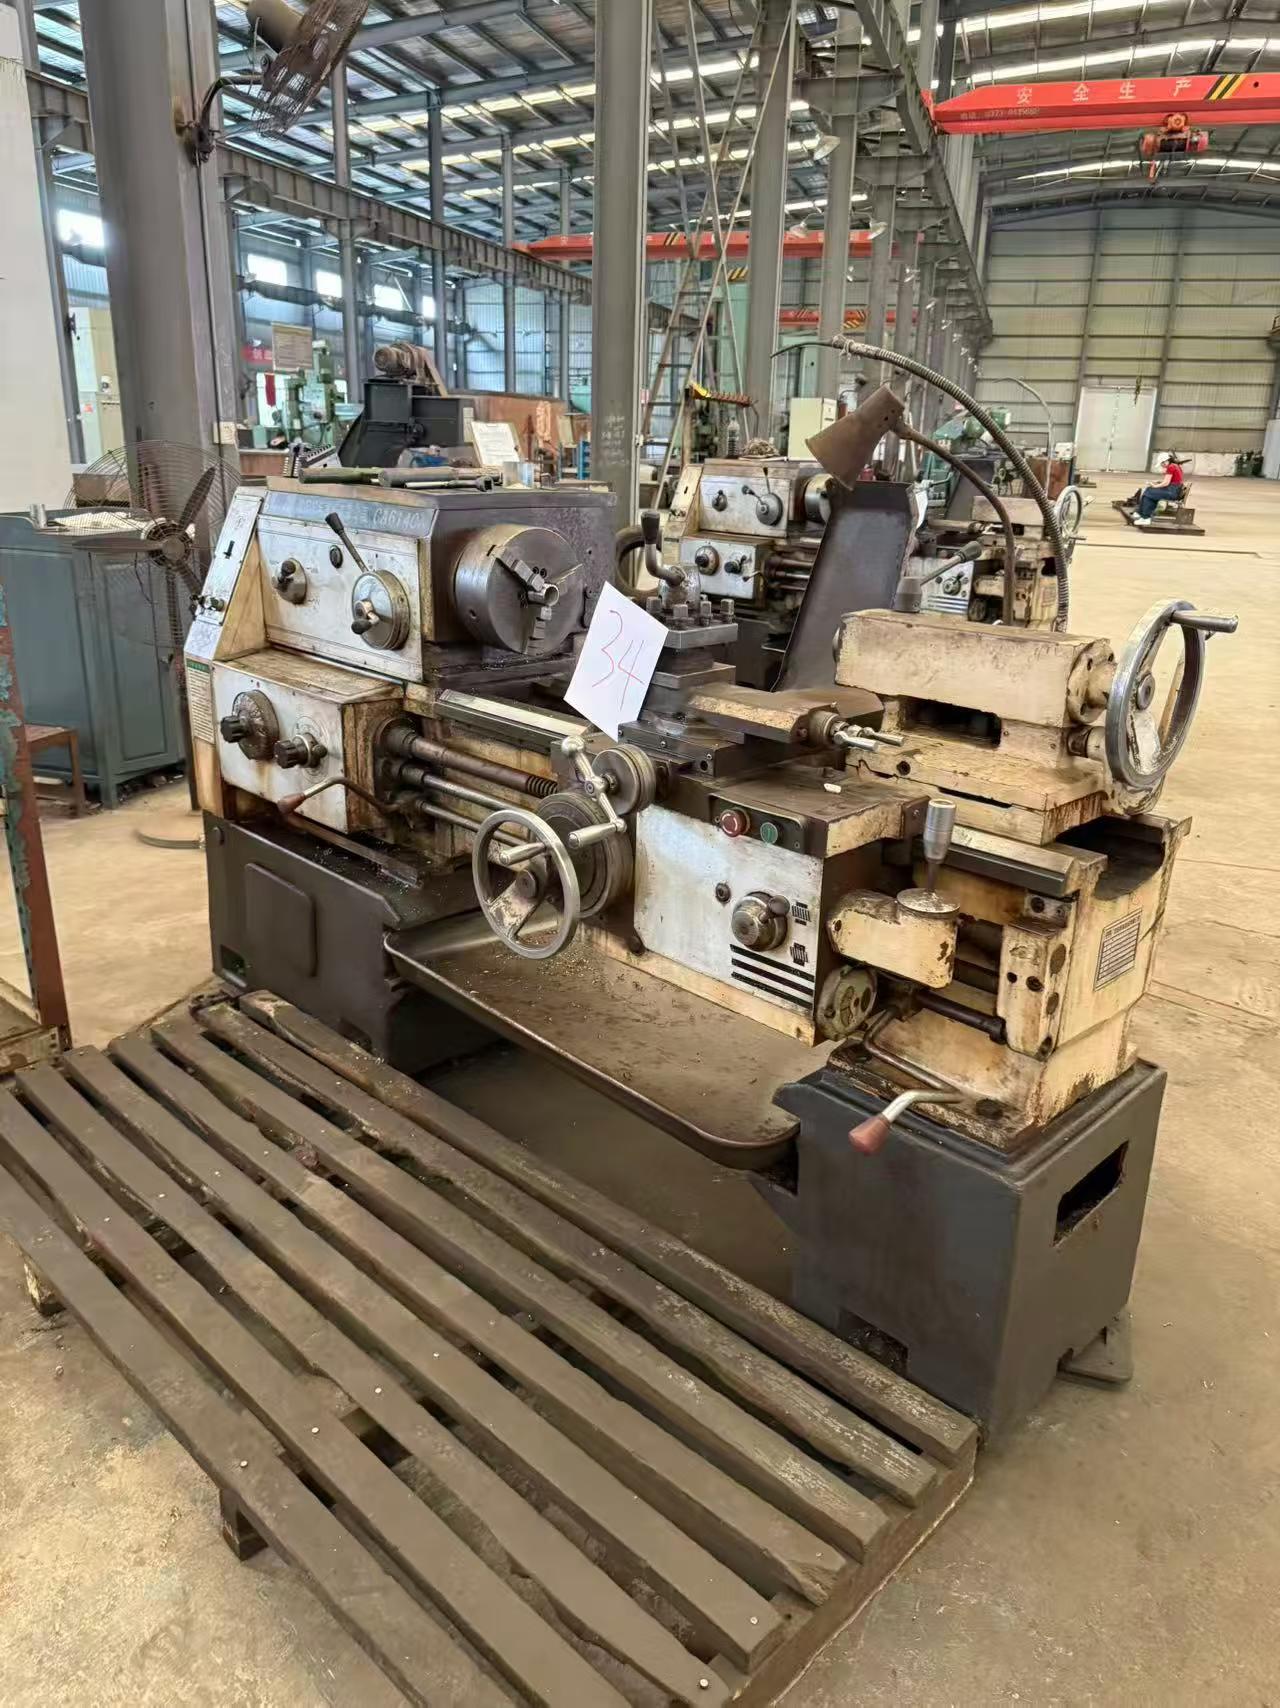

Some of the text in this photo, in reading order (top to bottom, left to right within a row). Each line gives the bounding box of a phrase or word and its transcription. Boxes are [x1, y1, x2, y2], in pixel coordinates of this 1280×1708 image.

[1017, 79, 1192, 105] 安全生产
[591, 609, 646, 712] 34
